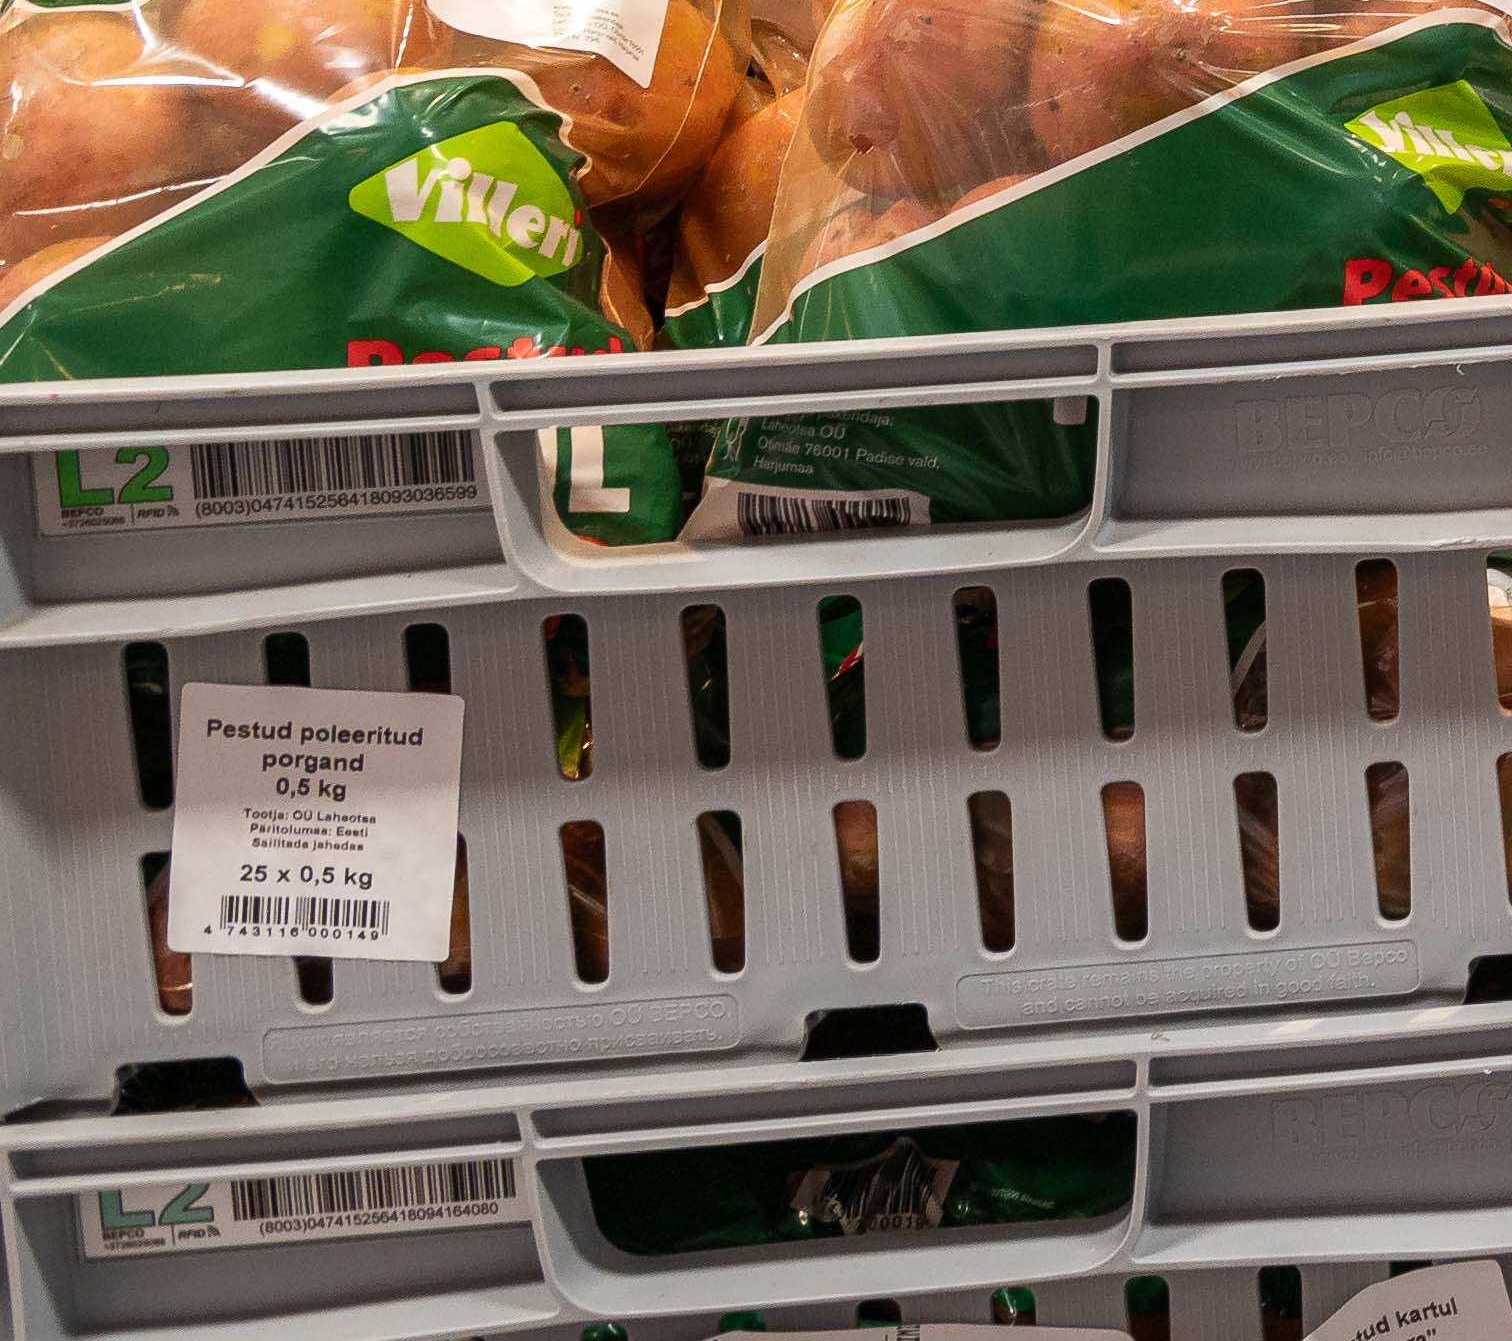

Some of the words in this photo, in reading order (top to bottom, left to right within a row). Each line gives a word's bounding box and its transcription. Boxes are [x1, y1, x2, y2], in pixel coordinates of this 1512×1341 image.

[385, 156, 581, 267] Villeri
[753, 457, 814, 475] Harjumaa
[803, 443, 850, 460] 76001
[855, 449, 903, 467] Padise
[57, 445, 173, 507] L2
[207, 718, 292, 741] Pestud
[300, 724, 424, 747] poleeritud
[262, 752, 365, 775] porgand
[276, 777, 310, 799] 0,5
[318, 779, 347, 802] kg
[240, 864, 267, 884] 25
[277, 870, 290, 883] x
[300, 866, 335, 888] 0,5
[344, 868, 373, 890] kg
[1396, 1297, 1458, 1329] kartul
